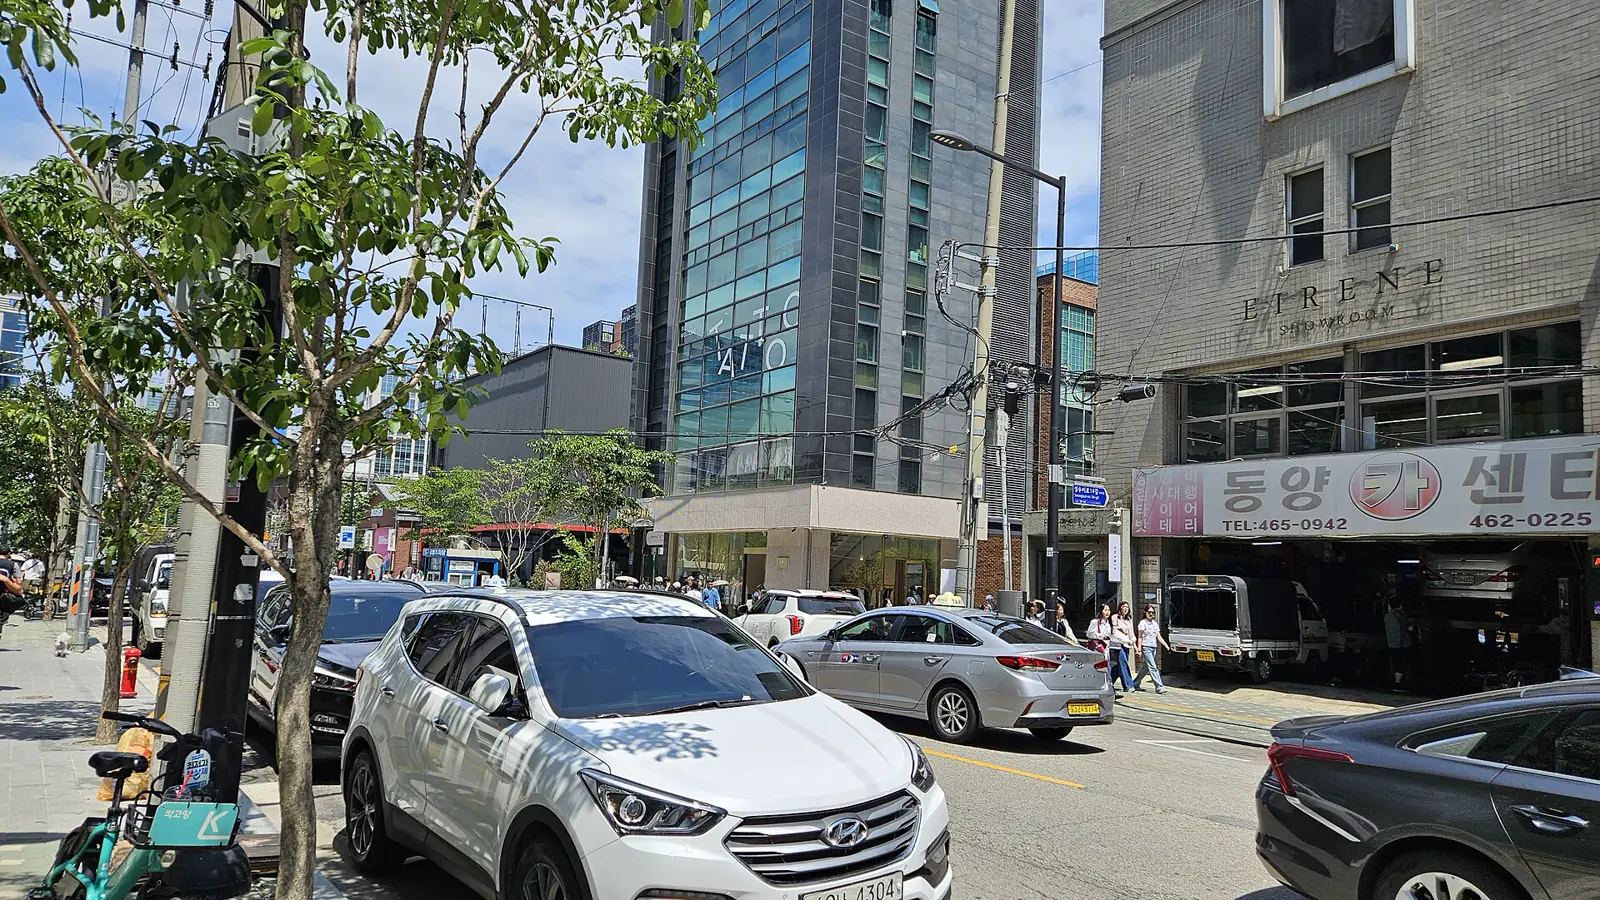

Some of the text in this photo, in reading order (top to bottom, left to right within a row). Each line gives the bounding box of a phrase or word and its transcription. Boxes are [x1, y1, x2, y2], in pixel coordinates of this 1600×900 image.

[1242, 258, 1444, 321] EIRENE
[1279, 304, 1395, 337] SHOWROOM
[1223, 465, 1331, 513] 동양
[1359, 460, 1430, 511] 카
[1135, 517, 1198, 533] 밧데리
[1222, 517, 1348, 532] TEL:465-0942
[1469, 511, 1592, 528] 462-0225
[856, 878, 895, 900] 4304
